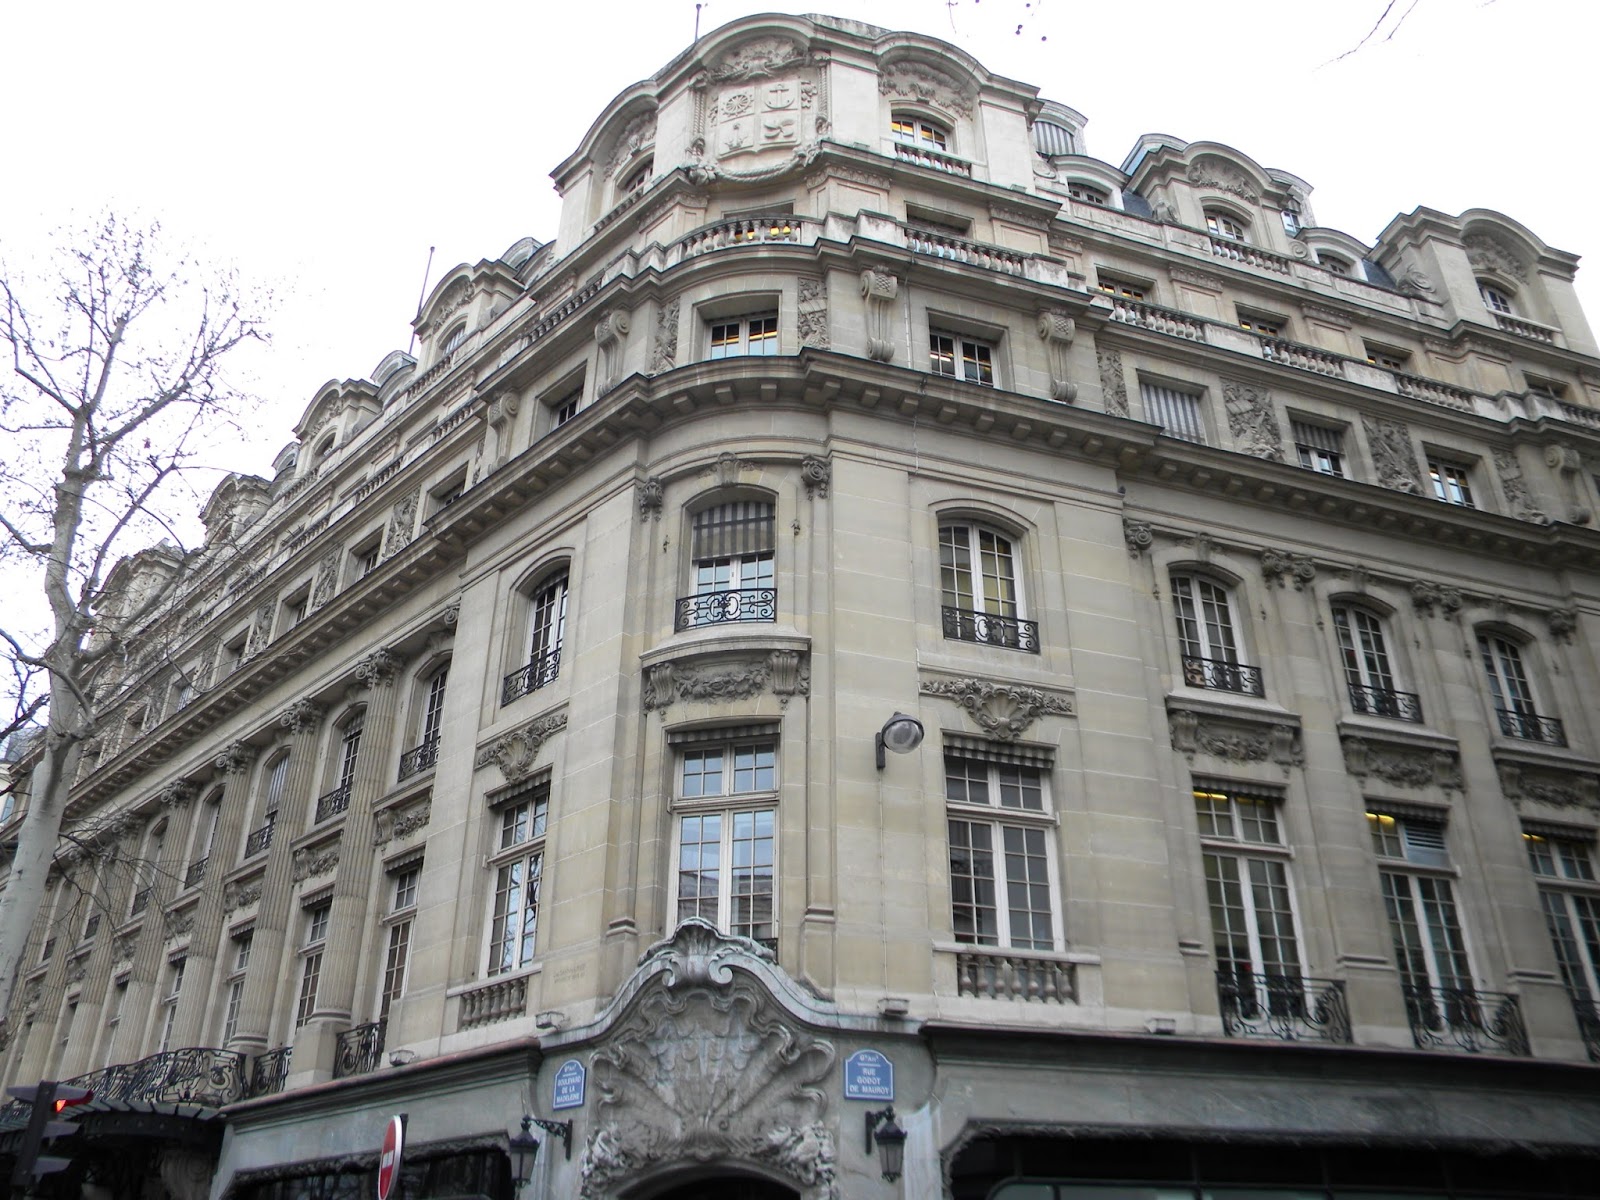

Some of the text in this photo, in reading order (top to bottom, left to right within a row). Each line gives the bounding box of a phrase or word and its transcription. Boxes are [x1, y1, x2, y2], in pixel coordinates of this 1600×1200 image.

[862, 1068, 876, 1076] RUE
[558, 1076, 581, 1086] BOULEVARD
[857, 1076, 881, 1085] GODOT
[562, 1086, 568, 1094] DE
[849, 1084, 890, 1095] DE MAUROY
[556, 1093, 580, 1103] MADELEINE
